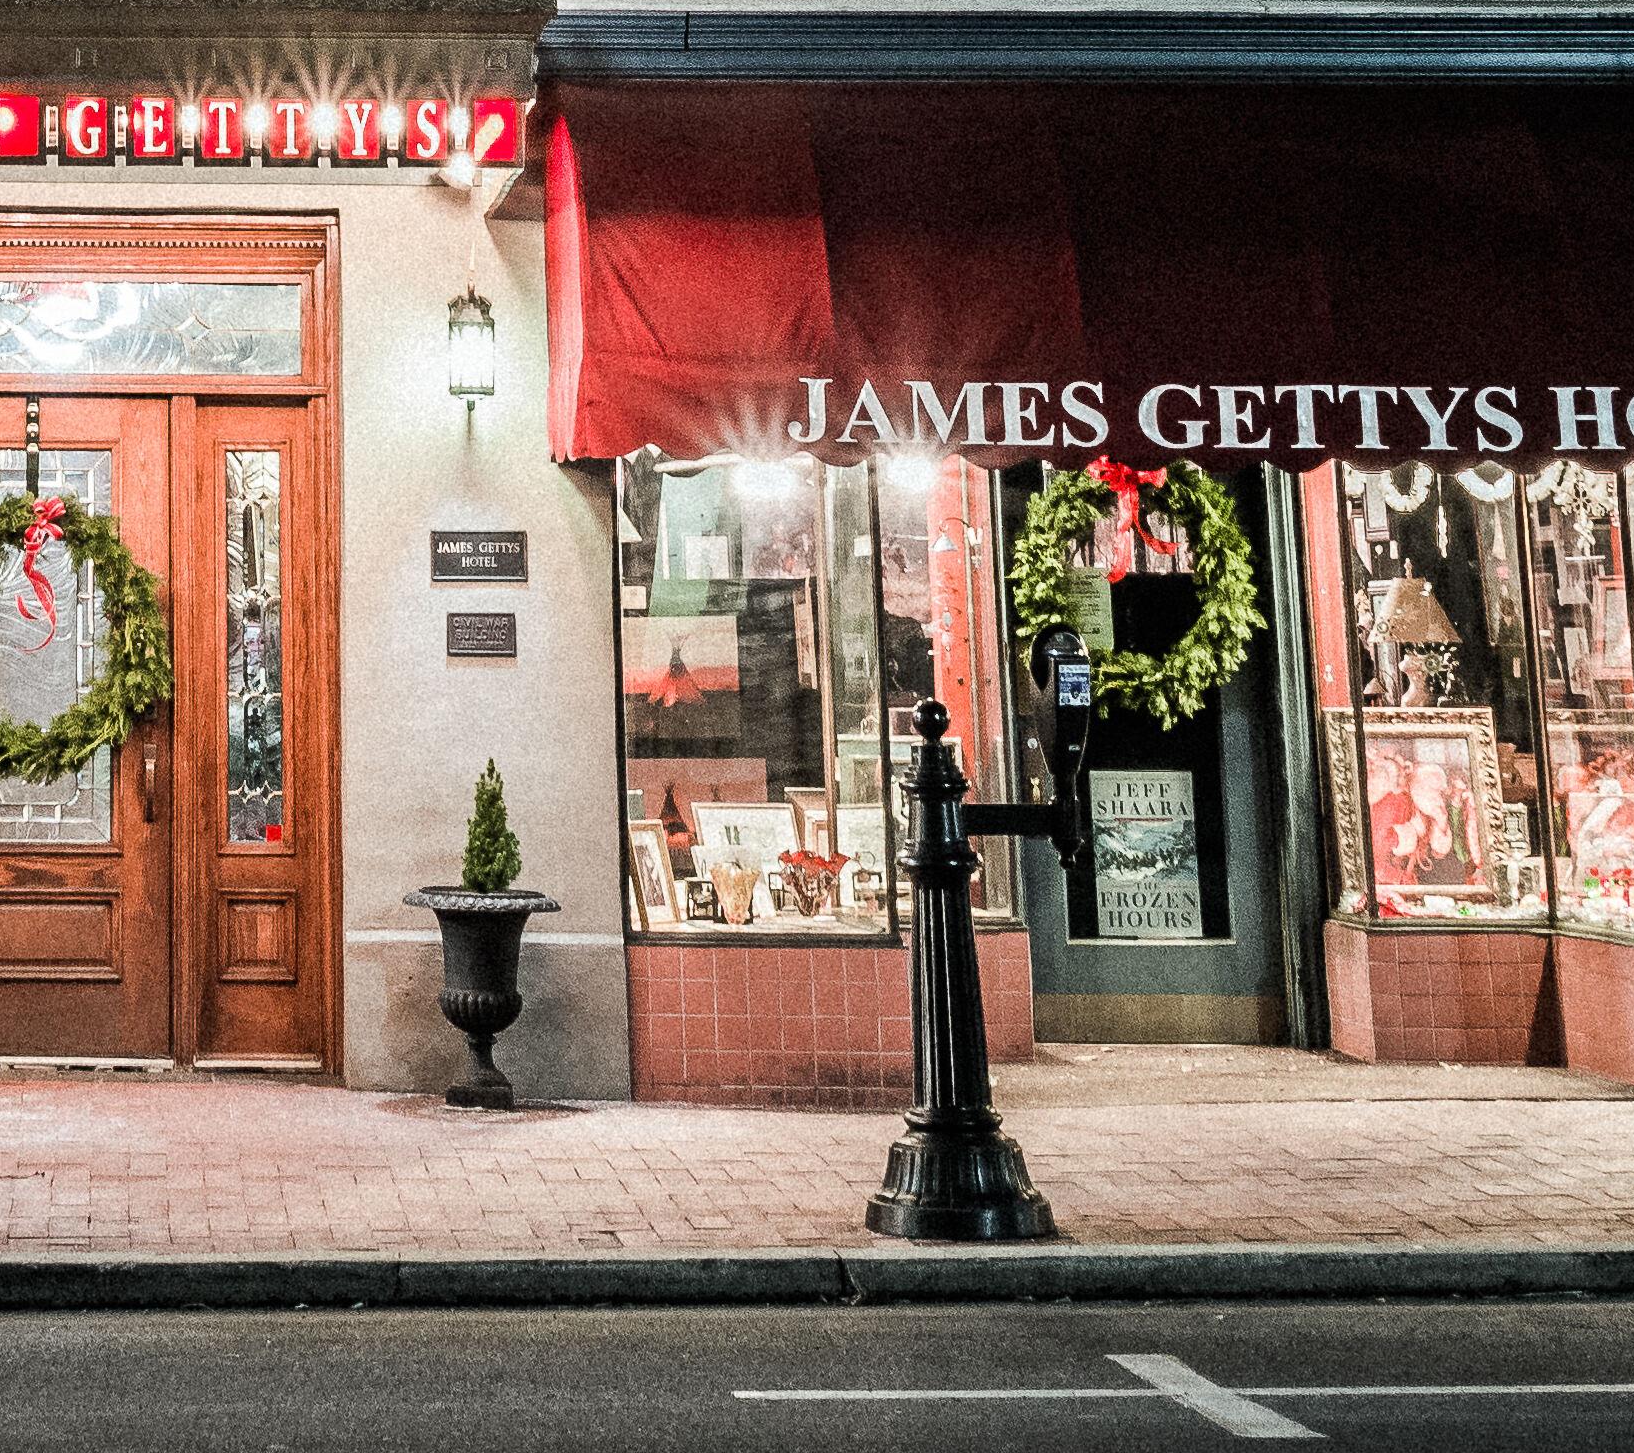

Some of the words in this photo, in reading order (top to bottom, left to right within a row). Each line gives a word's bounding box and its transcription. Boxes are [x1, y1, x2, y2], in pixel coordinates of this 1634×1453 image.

[69, 100, 439, 159] GETTYS
[788, 377, 1110, 449] JAMES
[1137, 383, 1524, 452] GETTYS
[436, 541, 475, 554] JAMES
[478, 541, 521, 554] GETTYS
[461, 556, 498, 568] HOTEL
[485, 616, 509, 630] WAR
[1112, 782, 1172, 798] JEFF
[1095, 800, 1190, 816] SHAARA
[1098, 891, 1198, 910] FROZEN
[1107, 910, 1193, 929] HOURS
